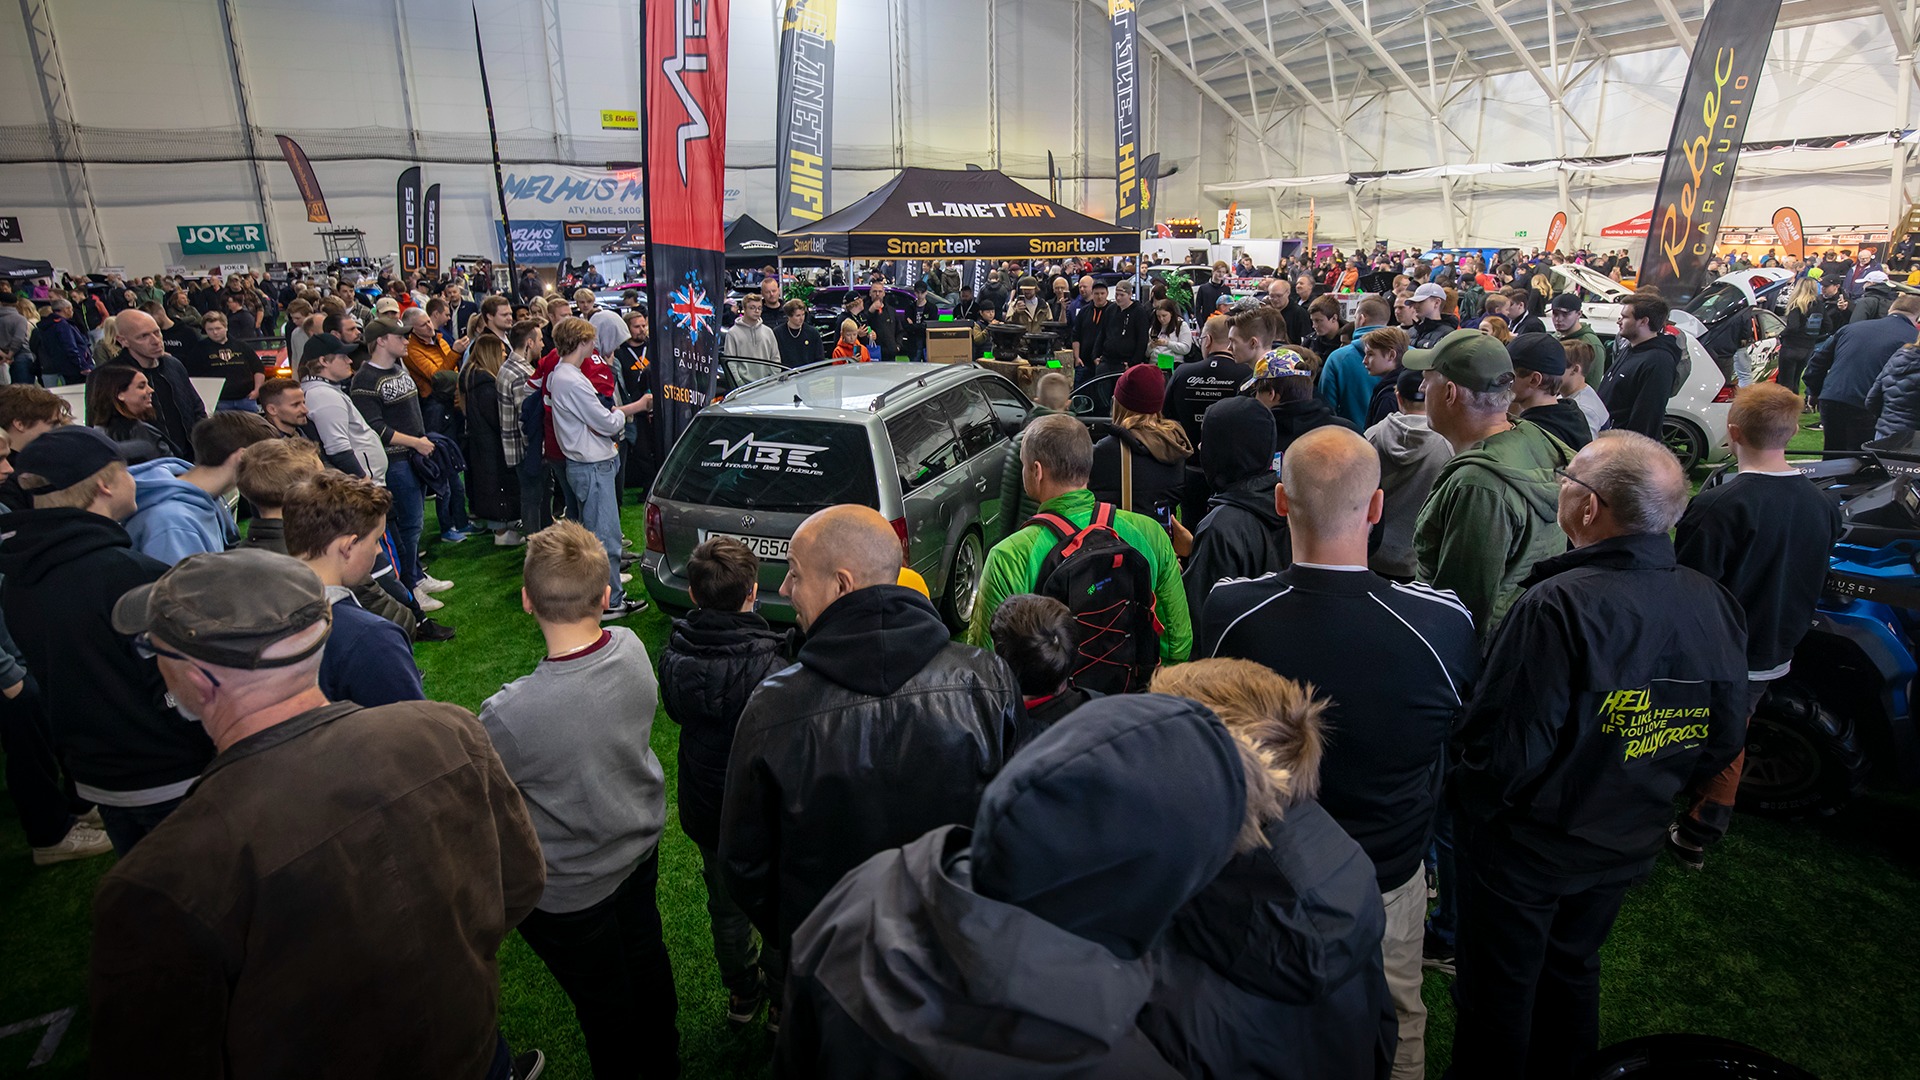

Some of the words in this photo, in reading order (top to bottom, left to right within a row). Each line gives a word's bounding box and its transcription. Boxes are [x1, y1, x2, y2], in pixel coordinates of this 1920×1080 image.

[1659, 47, 1735, 279] Rebec
[1693, 199, 1716, 256] CAR
[1711, 75, 1749, 176] AUDIO
[504, 173, 619, 204] MELHUS
[568, 206, 588, 215] ATV,
[589, 206, 617, 215] HAGE,
[617, 206, 641, 215] SKOG
[185, 226, 261, 244] JOKER
[225, 243, 256, 252] engros
[673, 347, 713, 365] British
[678, 358, 710, 374] Audio
[1186, 375, 1205, 387] Alfa
[1205, 375, 1235, 386] Romeo
[708, 432, 830, 468] VIBE
[725, 461, 759, 470] Innovative
[762, 464, 781, 472] Bass
[785, 466, 824, 476] Enclosures
[1597, 687, 1652, 716] HELL
[1610, 712, 1626, 726] IS
[1630, 710, 1652, 727] LIKE
[1601, 724, 1615, 734] IF
[1619, 726, 1645, 738] YOU
[1644, 719, 1668, 734] LOVE
[1623, 724, 1710, 763] RALLYCROSS
